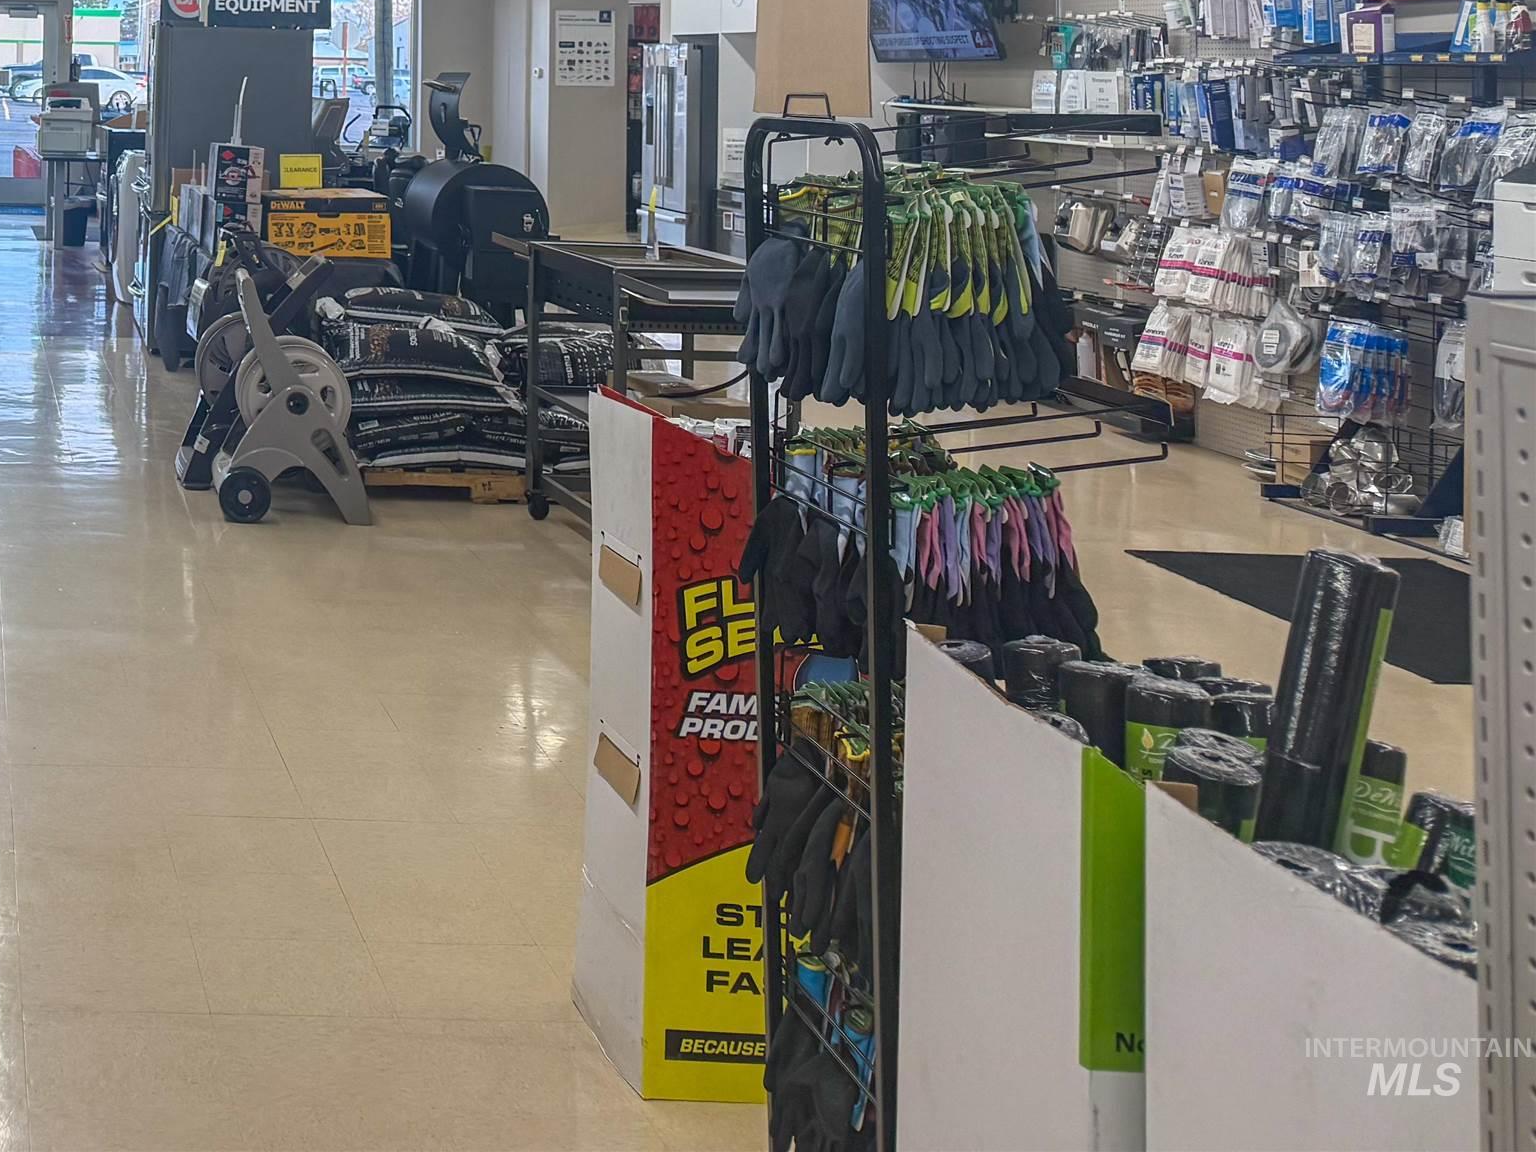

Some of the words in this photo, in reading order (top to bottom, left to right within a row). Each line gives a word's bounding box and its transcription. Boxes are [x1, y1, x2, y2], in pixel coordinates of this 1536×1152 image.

[684, 579, 755, 631] FL
[687, 691, 758, 716] FAM
[679, 717, 760, 741] PROD
[716, 903, 763, 928] ST
[706, 969, 764, 996] FA
[679, 1038, 767, 1057] BECAUSE
